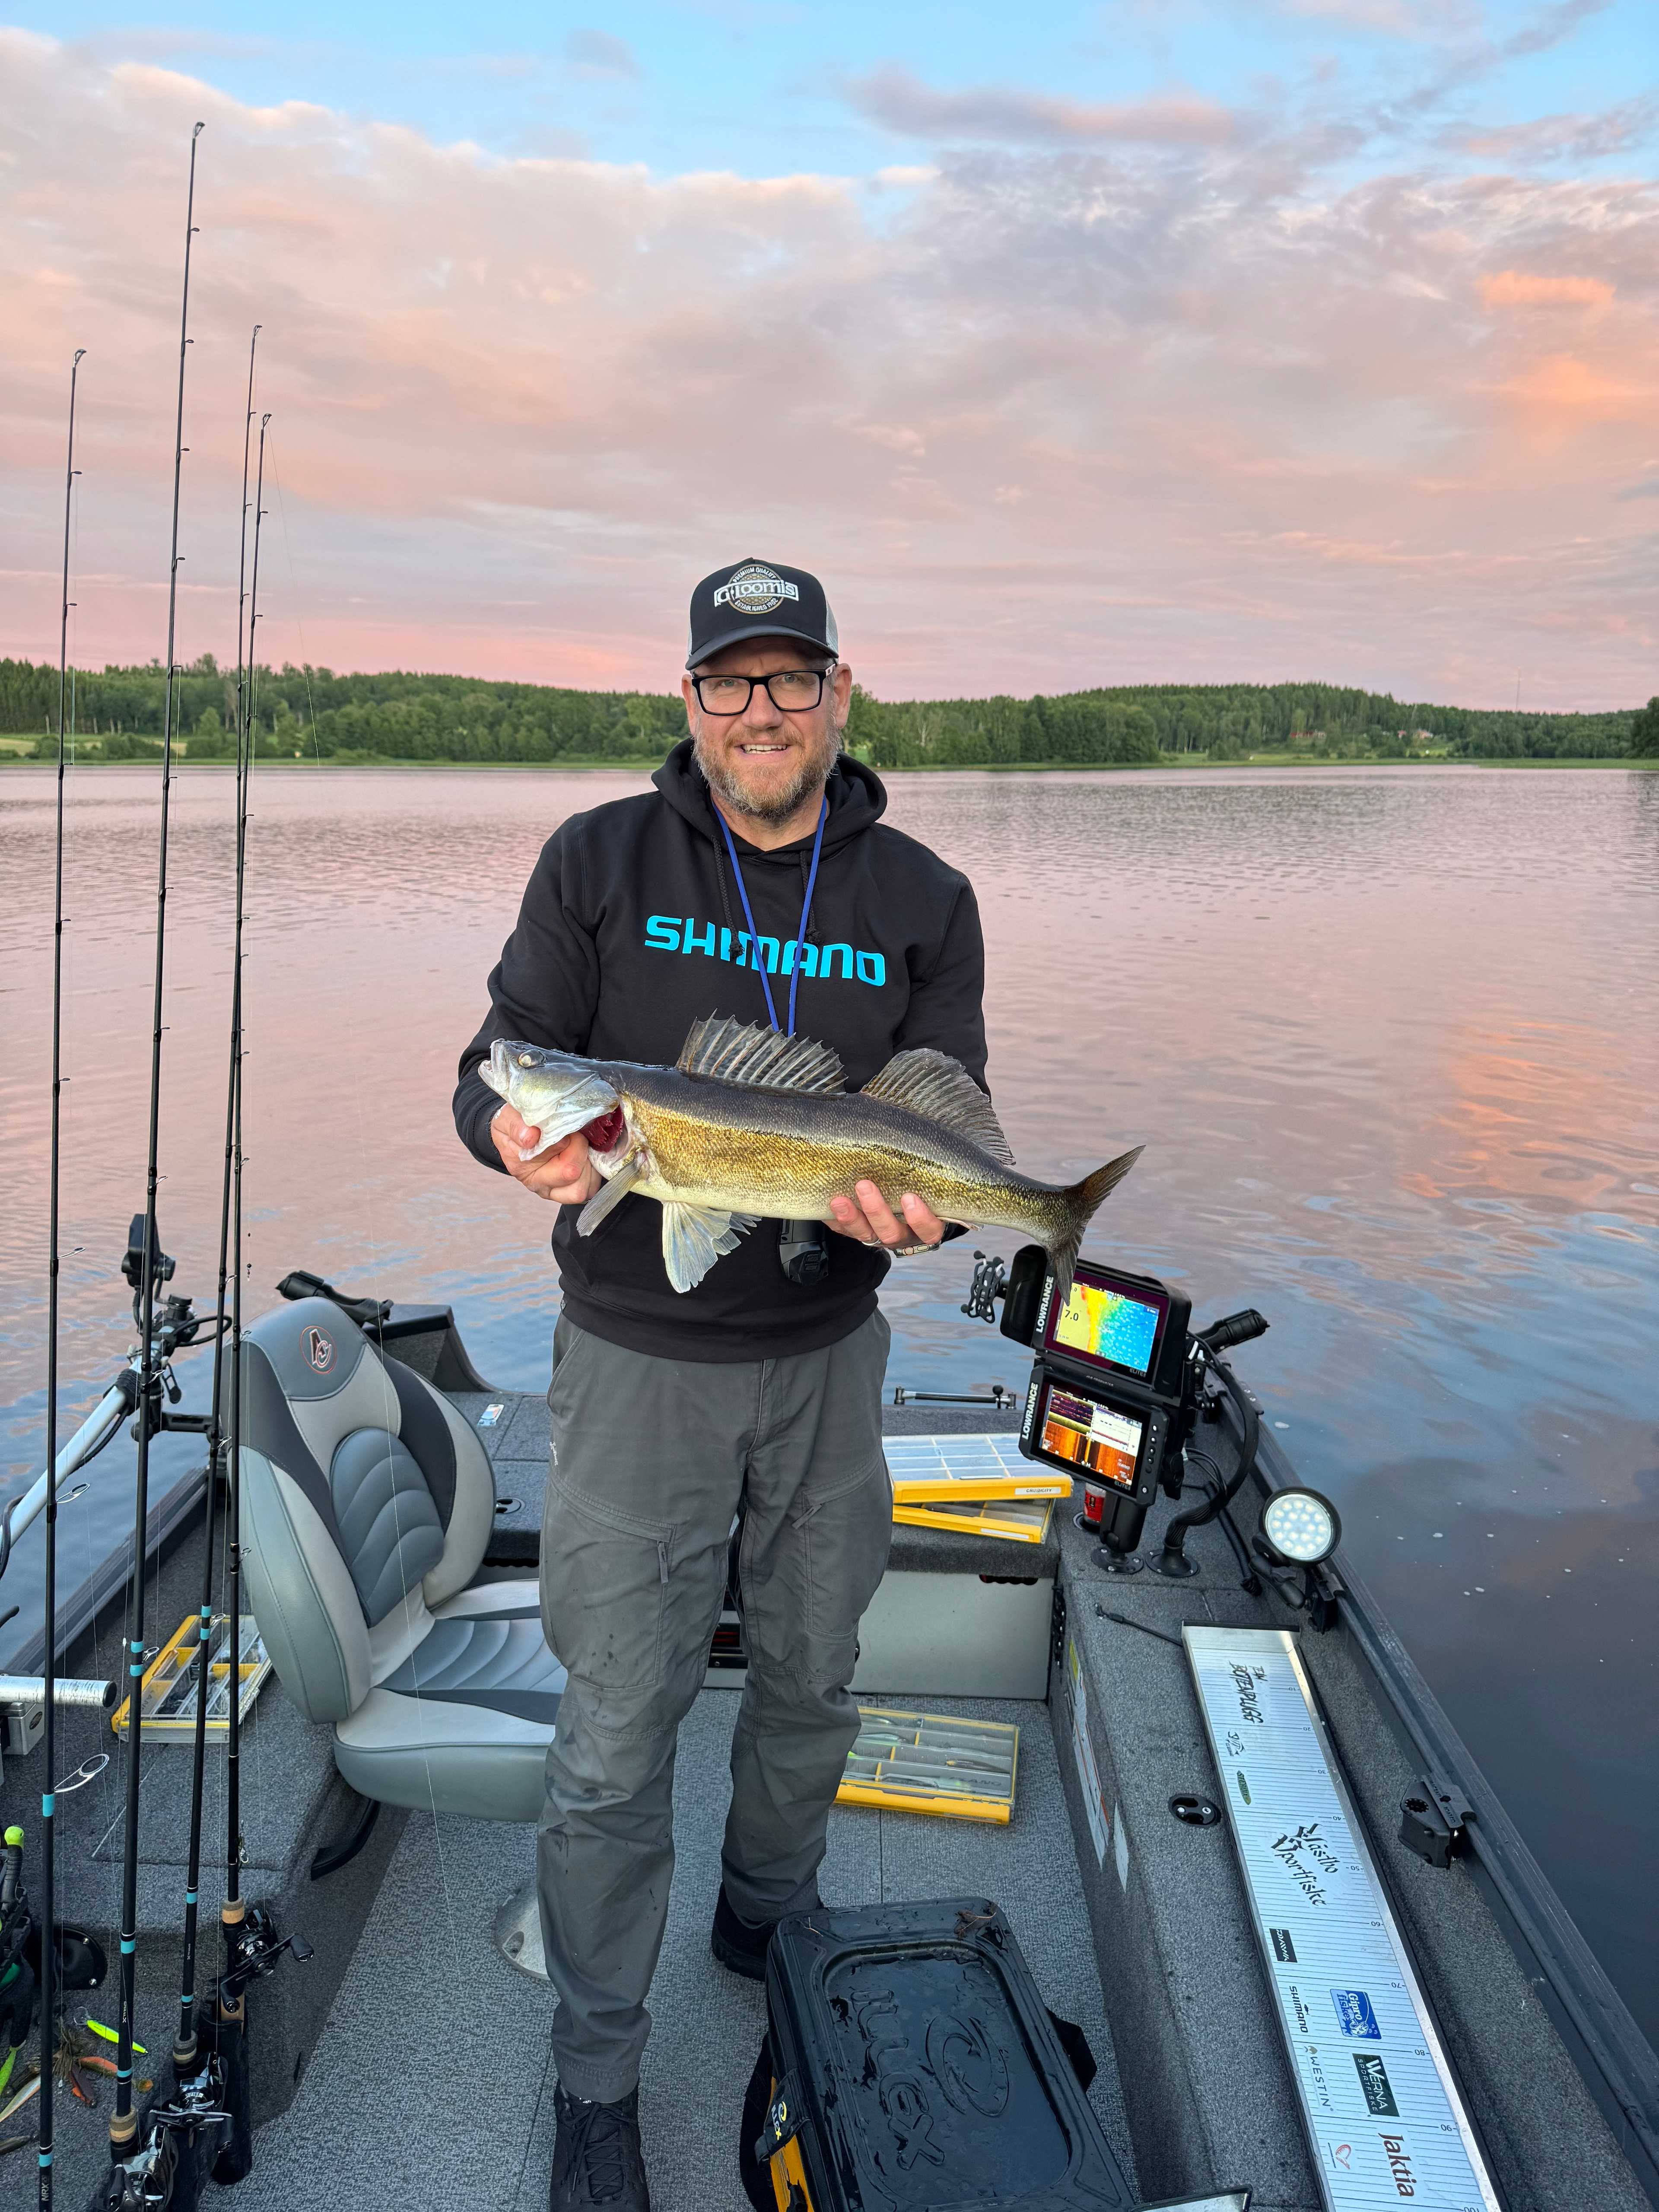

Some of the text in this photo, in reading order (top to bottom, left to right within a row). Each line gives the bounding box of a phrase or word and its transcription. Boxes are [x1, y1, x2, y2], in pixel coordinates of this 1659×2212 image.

[756, 567, 776, 579] QUALITY
[645, 915, 886, 987] SHIMANO
[1036, 1275, 1054, 1333] LOWRANCE
[1065, 1309, 1079, 1321] 7.0
[1022, 1382, 1039, 1440] LOWRANCE
[1276, 1929, 1289, 1961] DAIWA
[1289, 1986, 1308, 2033] SHIMANO
[1337, 1993, 1350, 2020] fiske
[1348, 1993, 1362, 2021] Gipro
[851, 1989, 945, 2171] ILLEX
[1309, 2056, 1329, 2107] WESTIN
[1357, 2058, 1378, 2112] SPORTFISKE
[1365, 2059, 1388, 2110] WERNA
[1378, 2133, 1417, 2196] Jaktia
[41, 2181, 50, 2202] NRX
